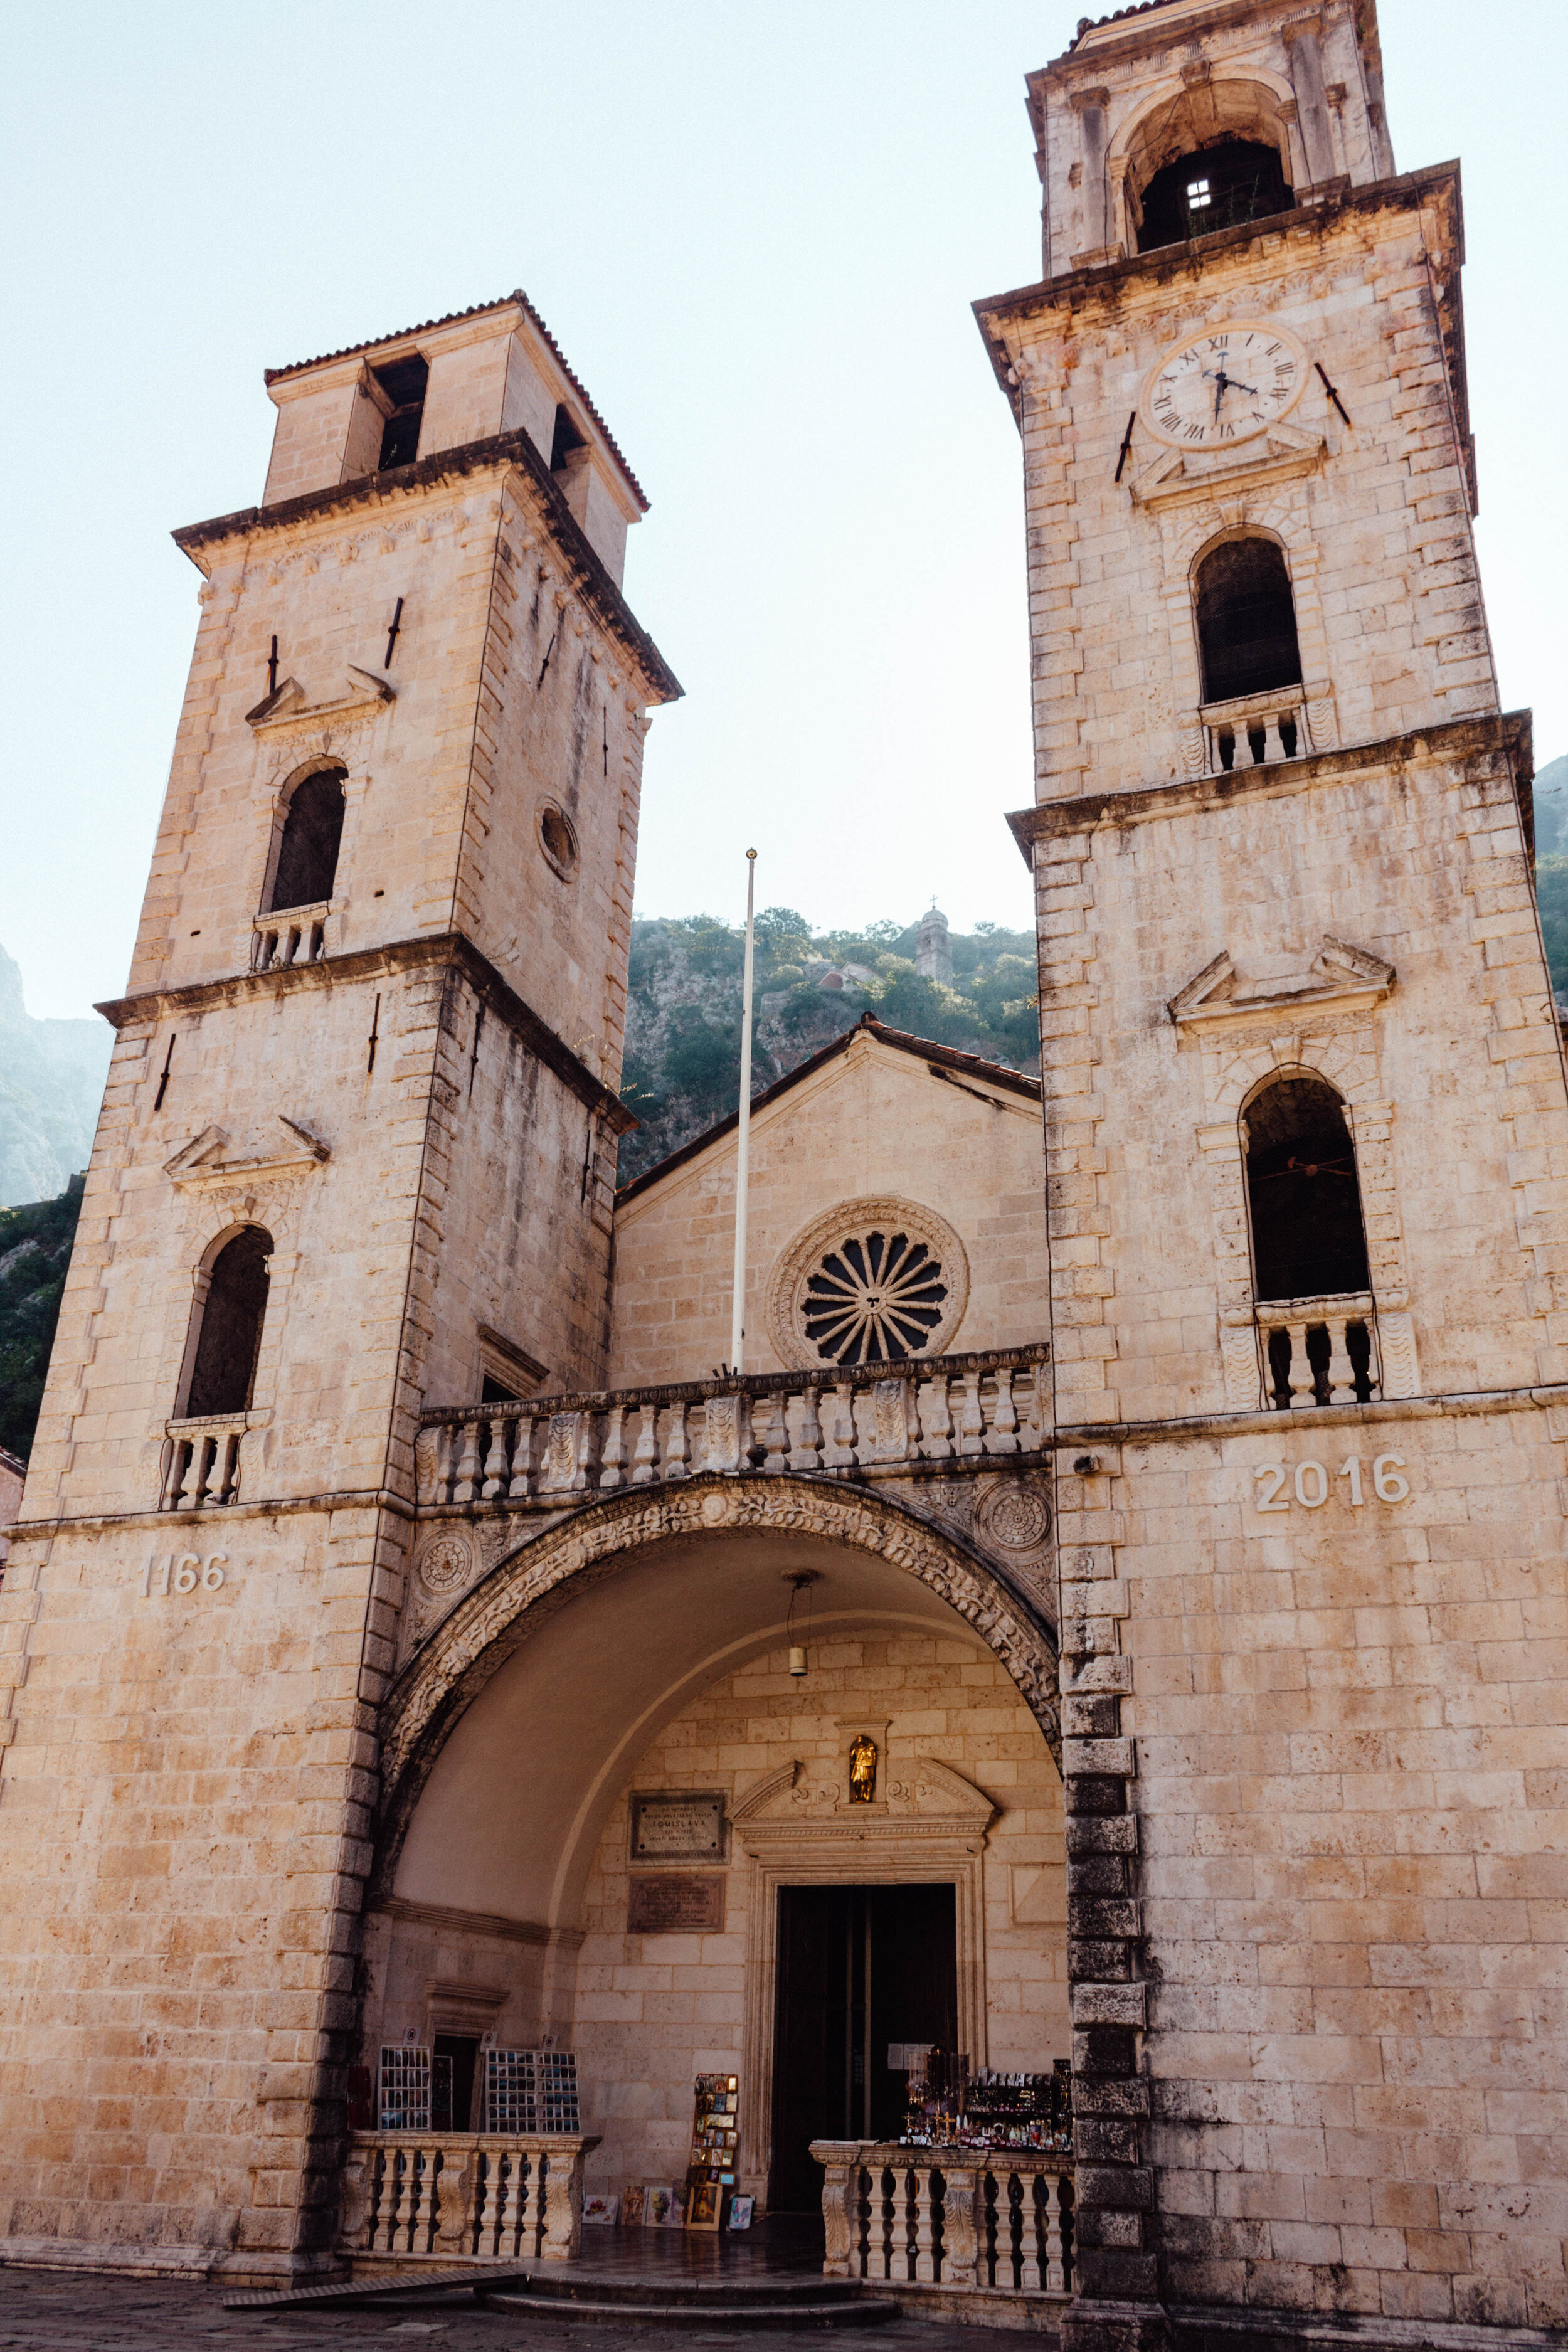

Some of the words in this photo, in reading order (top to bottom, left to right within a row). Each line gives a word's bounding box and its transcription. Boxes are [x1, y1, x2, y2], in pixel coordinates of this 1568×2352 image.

[1208, 334, 1228, 352] XII
[1264, 342, 1282, 356] II
[1178, 347, 1199, 366] XI
[1274, 362, 1294, 376] III
[1158, 374, 1178, 383] X
[1254, 1453, 1410, 1513] 2016
[137, 1552, 228, 1598] 1166
